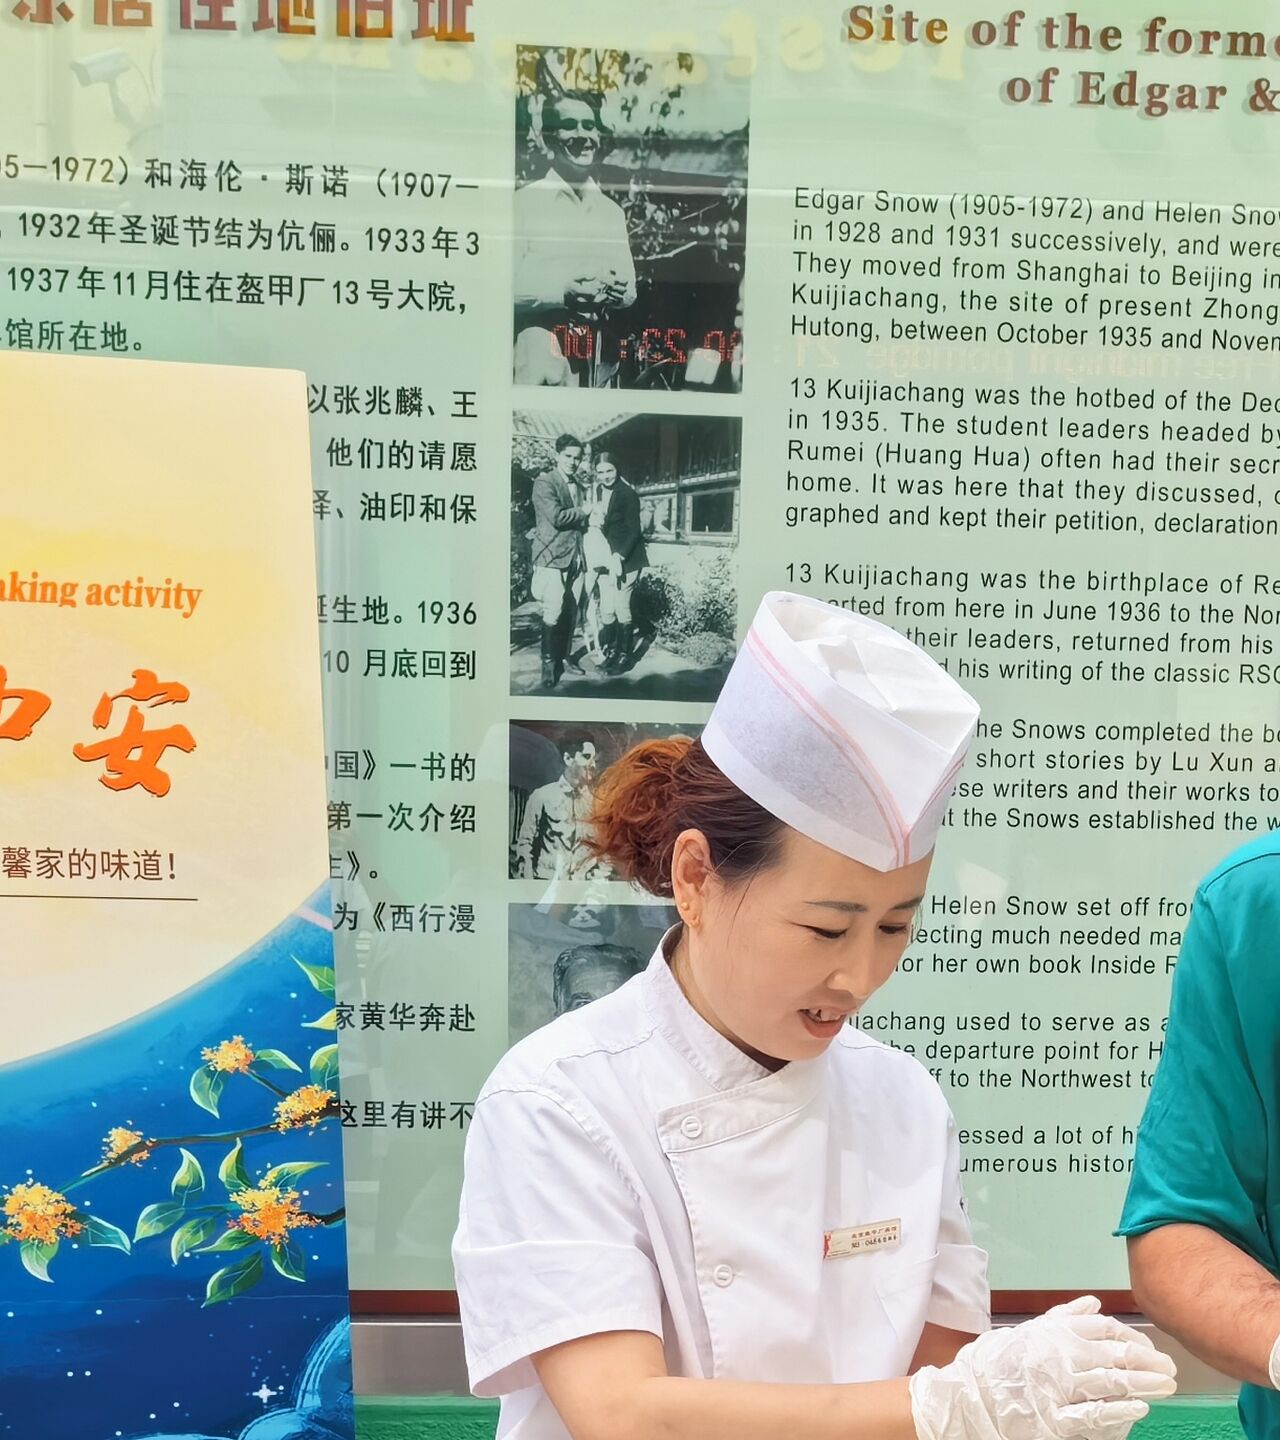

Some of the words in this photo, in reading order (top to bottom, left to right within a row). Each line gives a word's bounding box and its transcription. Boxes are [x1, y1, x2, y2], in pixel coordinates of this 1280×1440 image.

[847, 3, 948, 45] Site
[971, 9, 1026, 48] of
[1041, 11, 1123, 52] the
[1006, 66, 1060, 104] of
[1075, 69, 1228, 118] Edgar
[794, 186, 866, 216] Edgar
[874, 189, 939, 214] Snow
[949, 192, 1093, 226] (1905-1972)
[1102, 199, 1145, 222] and
[1154, 199, 1222, 225] Helen
[793, 218, 813, 242] in
[824, 219, 881, 244] 1928
[890, 223, 934, 246] and
[945, 224, 999, 249] 1931
[1010, 230, 1167, 260] successively,
[1177, 233, 1220, 256] and
[792, 250, 852, 280] They
[862, 255, 942, 278] moved
[952, 256, 1006, 280] from
[1016, 258, 1129, 289] Shanghai
[1139, 264, 1161, 286] to
[1171, 264, 1253, 295] Beijing
[791, 281, 947, 315] Kuijiachang,
[959, 288, 998, 312] the
[1008, 290, 1054, 314] site
[1064, 292, 1090, 315] of
[1098, 297, 1192, 321] present
[791, 313, 880, 344] Hutong,
[890, 317, 987, 343] between
[996, 321, 1089, 346] October
[1098, 325, 1152, 348] 1935
[1160, 327, 1203, 350] and
[790, 376, 817, 400] 13
[826, 377, 965, 409] Kuijiachang
[974, 387, 1020, 406] was
[1030, 384, 1066, 407] the
[1075, 385, 1155, 410] hotbed
[1164, 388, 1189, 411] of
[1195, 390, 1232, 413] the
[326, 436, 478, 472] 他们的请愿
[85, 578, 204, 619] activity
[957, 657, 990, 679] his
[998, 658, 1072, 686] writing
[1081, 659, 1104, 682] of
[1110, 660, 1146, 683] the
[1153, 661, 1230, 684] classic
[971, 716, 1003, 739] he
[1011, 717, 1086, 741] Snows
[1094, 720, 1211, 746] completed
[1219, 722, 1254, 744] the
[325, 748, 477, 783] 国》一书的
[975, 747, 1036, 770] short
[1045, 749, 1125, 771] stories
[1135, 749, 1163, 777] by
[1171, 750, 1199, 772] Lu
[1208, 751, 1254, 773] Xun
[326, 800, 477, 834] 第一次介绍
[332, 901, 477, 934] 为《西行漫
[931, 894, 997, 916] Helen
[1005, 894, 1068, 916] Snow
[1076, 897, 1111, 917] set
[1119, 896, 1151, 917] off
[1158, 896, 1194, 917] fro
[335, 1001, 477, 1032] 家黄华奔赴
